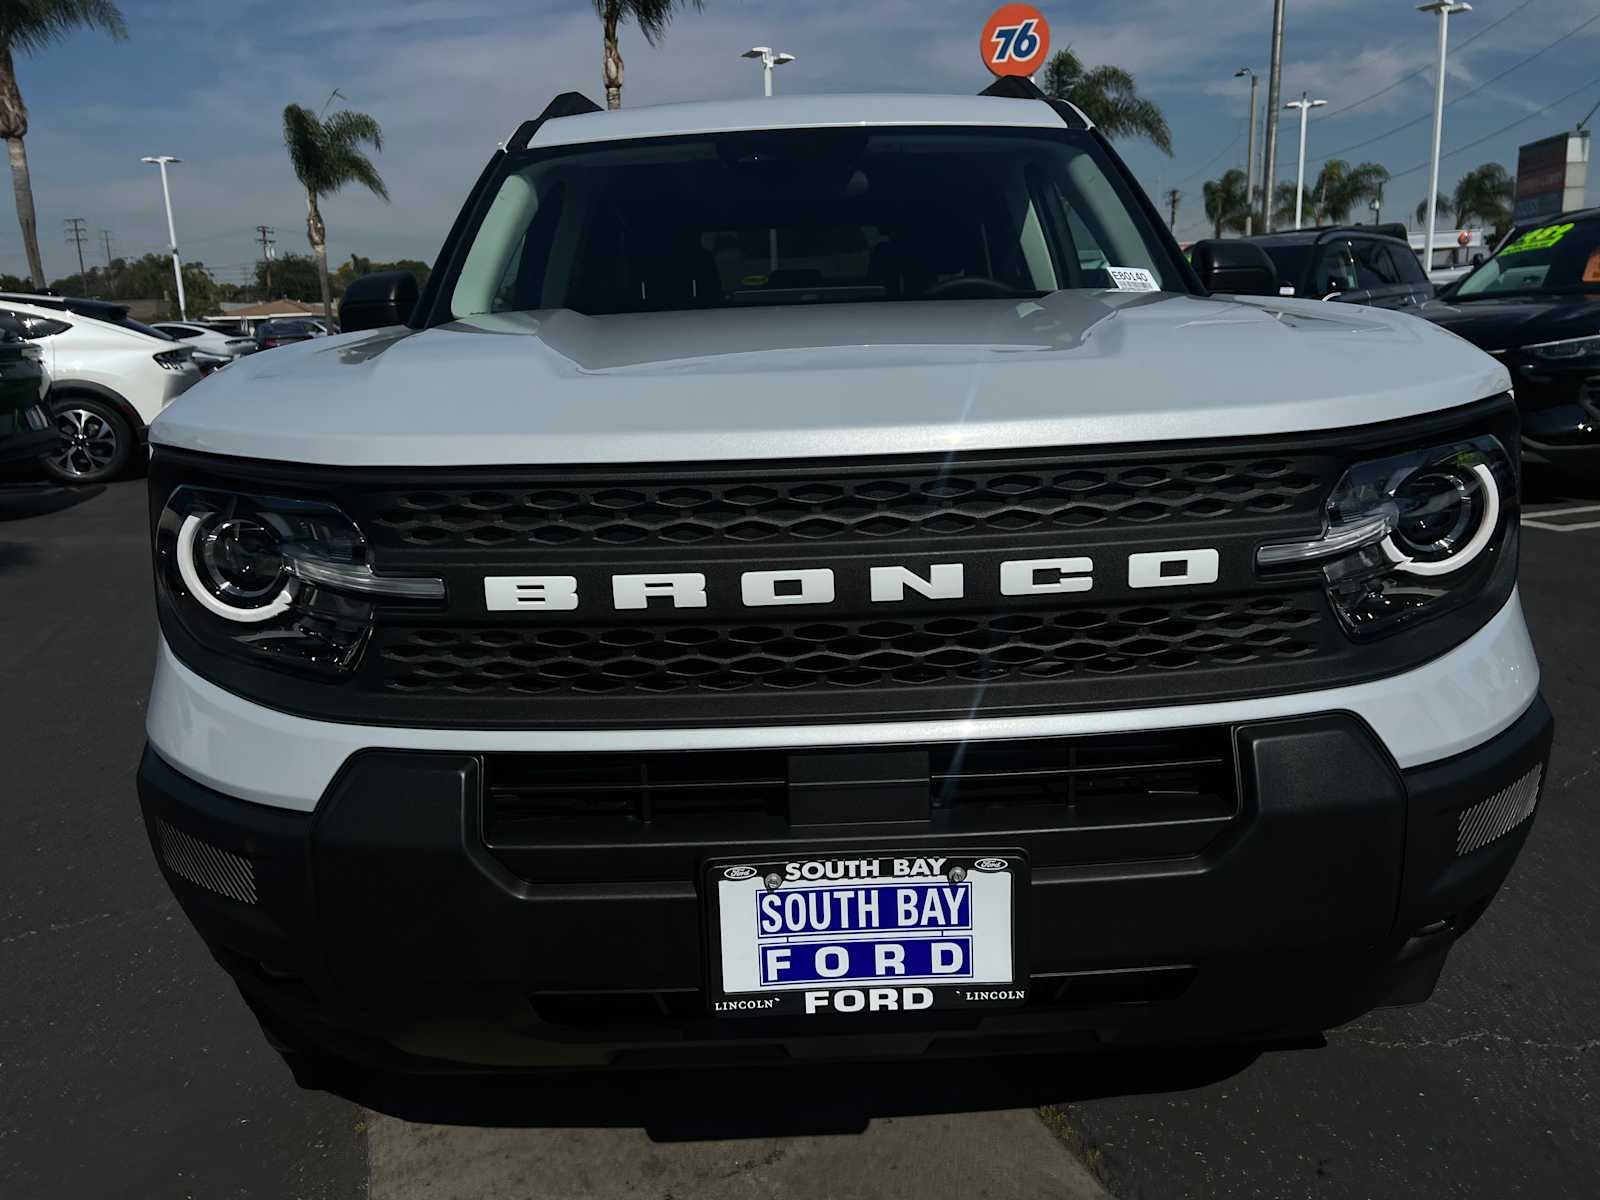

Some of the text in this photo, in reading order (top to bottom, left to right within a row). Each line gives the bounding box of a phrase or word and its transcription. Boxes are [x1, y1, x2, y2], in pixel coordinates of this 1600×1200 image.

[991, 19, 1040, 63] 76
[484, 549, 1219, 611] BRONCO
[785, 858, 947, 881] SOUTH BAY
[761, 886, 966, 933] SOUTH BAY
[766, 942, 964, 981] FORD
[715, 999, 774, 1011] LINCOLN
[804, 987, 934, 1014] FORD
[966, 990, 1025, 1001] LINCOLN
